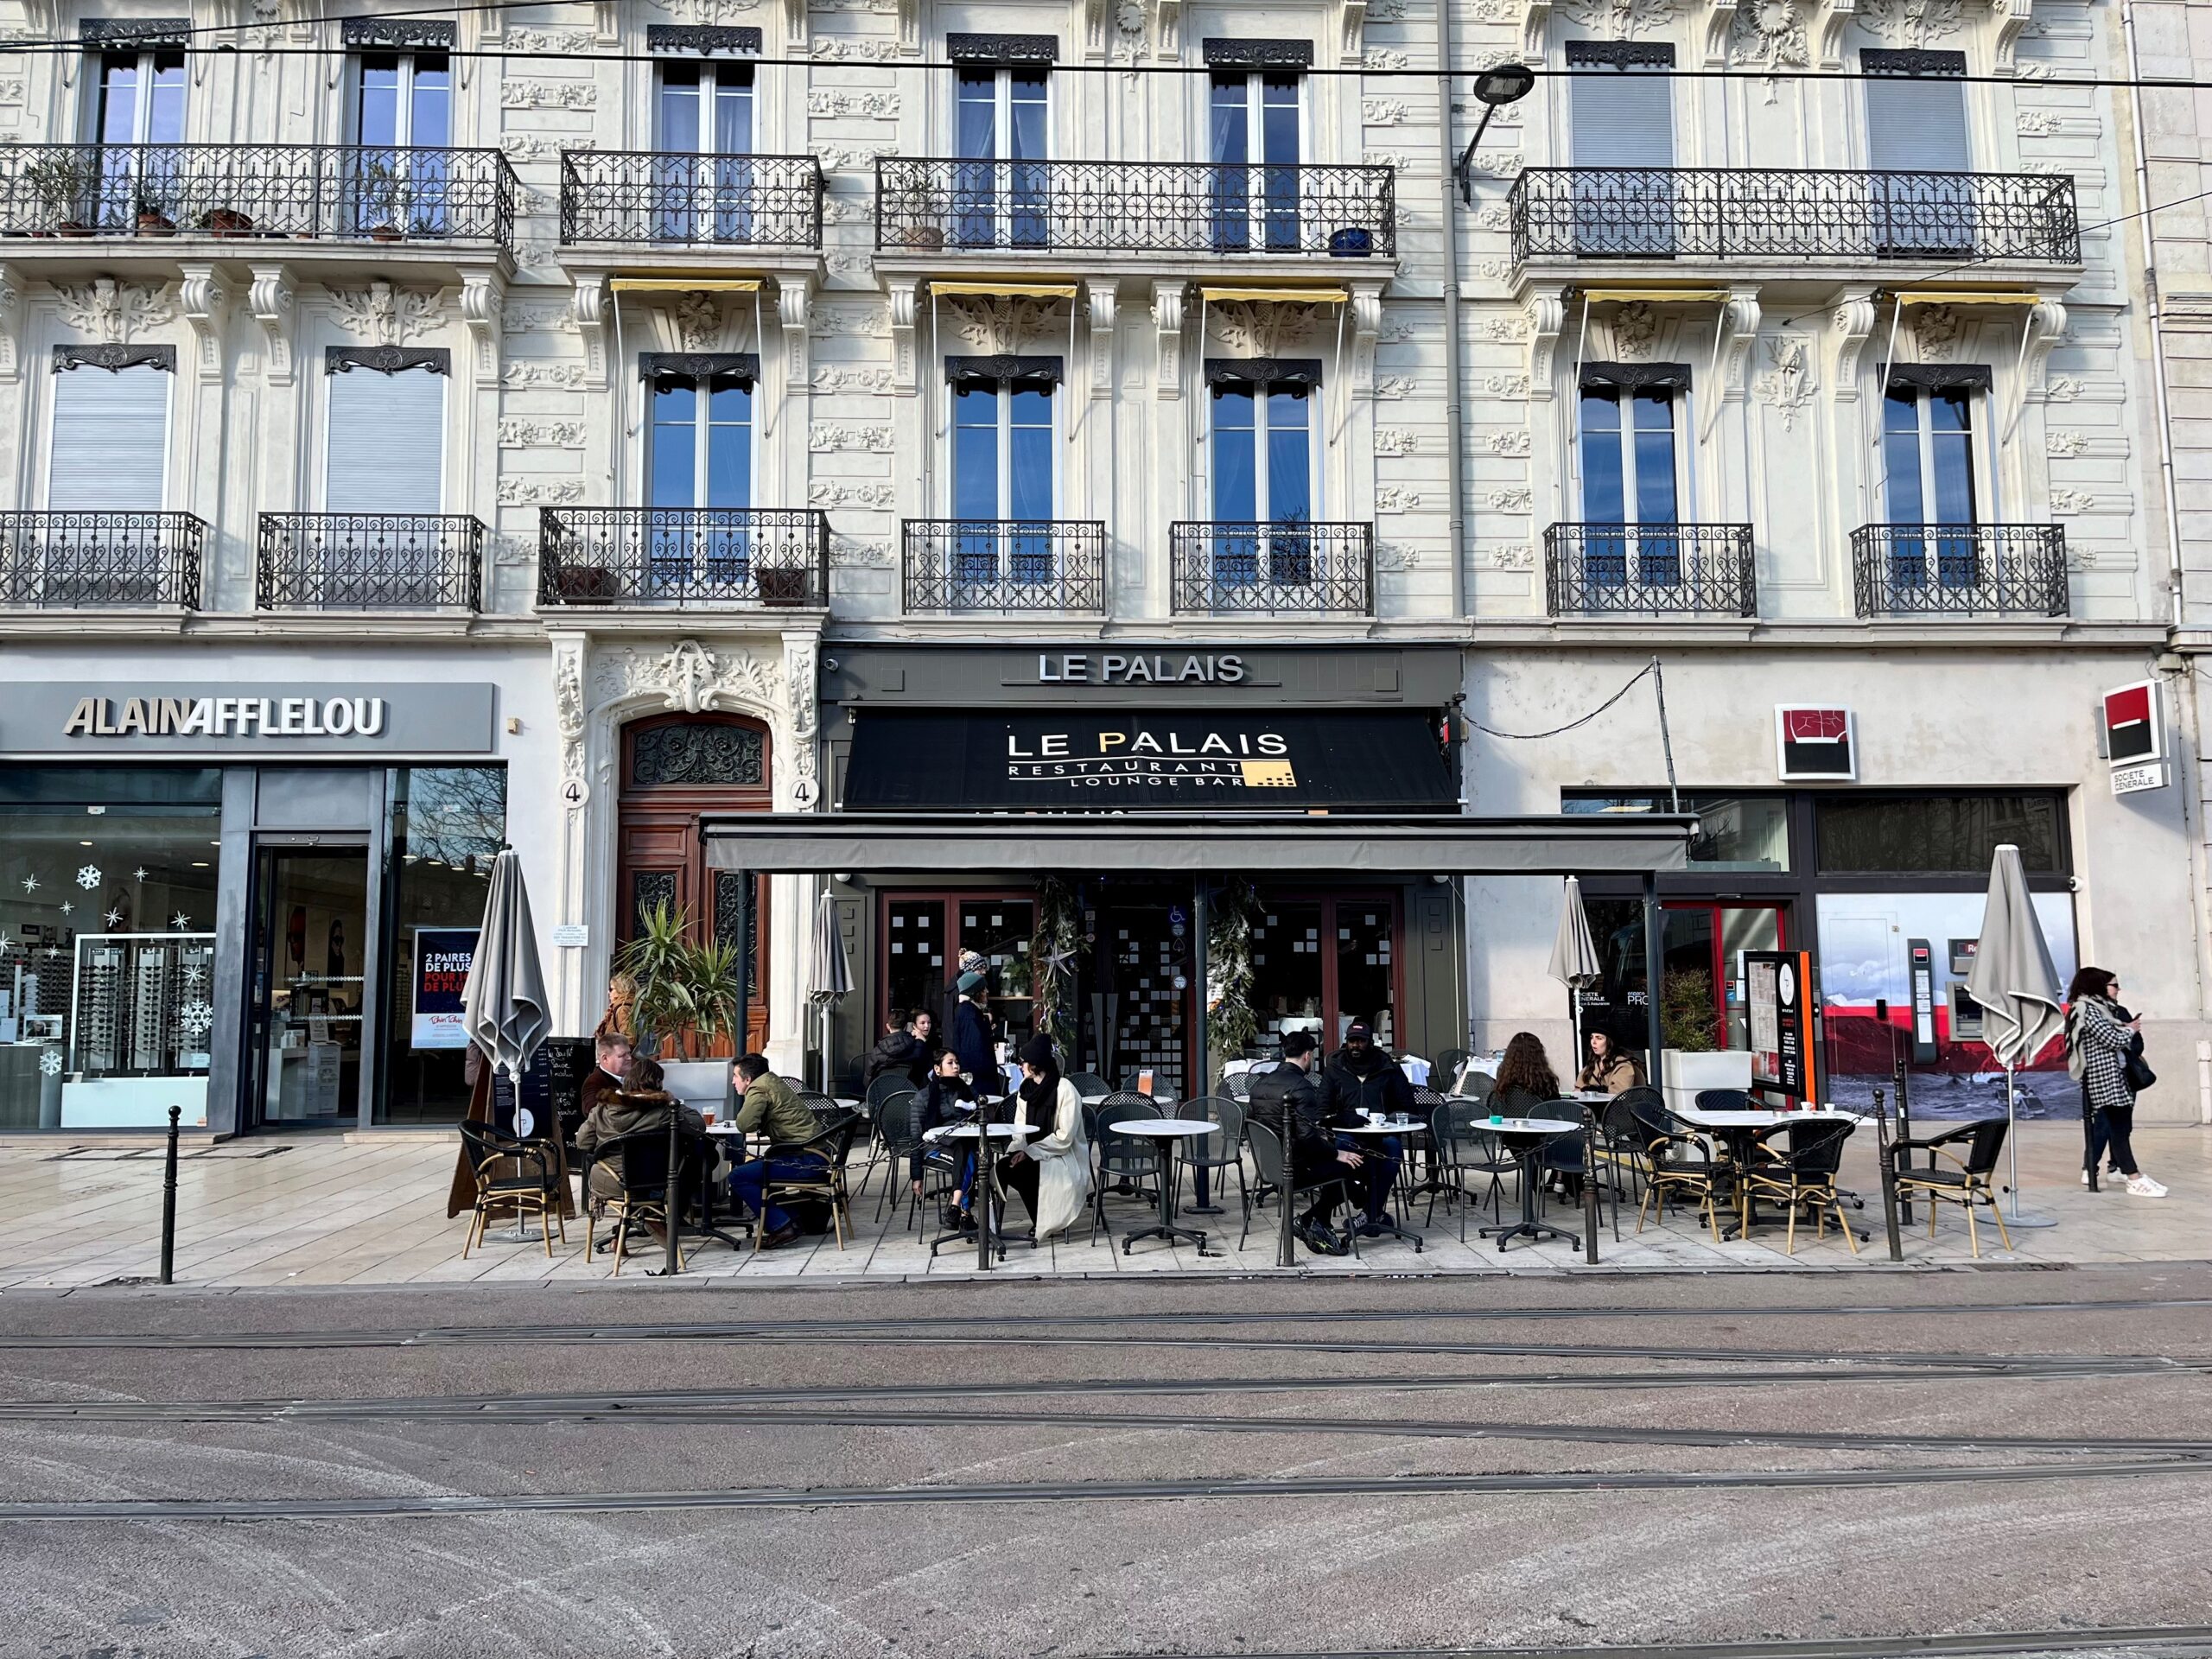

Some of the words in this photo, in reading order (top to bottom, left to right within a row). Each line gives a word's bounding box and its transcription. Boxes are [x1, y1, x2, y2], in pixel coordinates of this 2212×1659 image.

[1039, 654, 1088, 682] LE
[1103, 654, 1244, 682] PALAIS
[1009, 734, 1070, 756] LE
[1099, 732, 1288, 754] PALAIS
[1009, 760, 1239, 776] RESTAURANT
[1071, 776, 1179, 787] LOUNGE
[1195, 777, 1243, 787] BAR
[2114, 769, 2145, 783] SOCIETE
[2114, 776, 2155, 791] GENERALE
[565, 783, 581, 802] 4
[794, 783, 810, 802] 4
[425, 953, 433, 963] 2
[435, 952, 472, 963] PAIRES
[425, 963, 441, 973] DE
[443, 962, 471, 973] PLUS
[424, 972, 456, 982] POUR
[423, 982, 440, 993] DE
